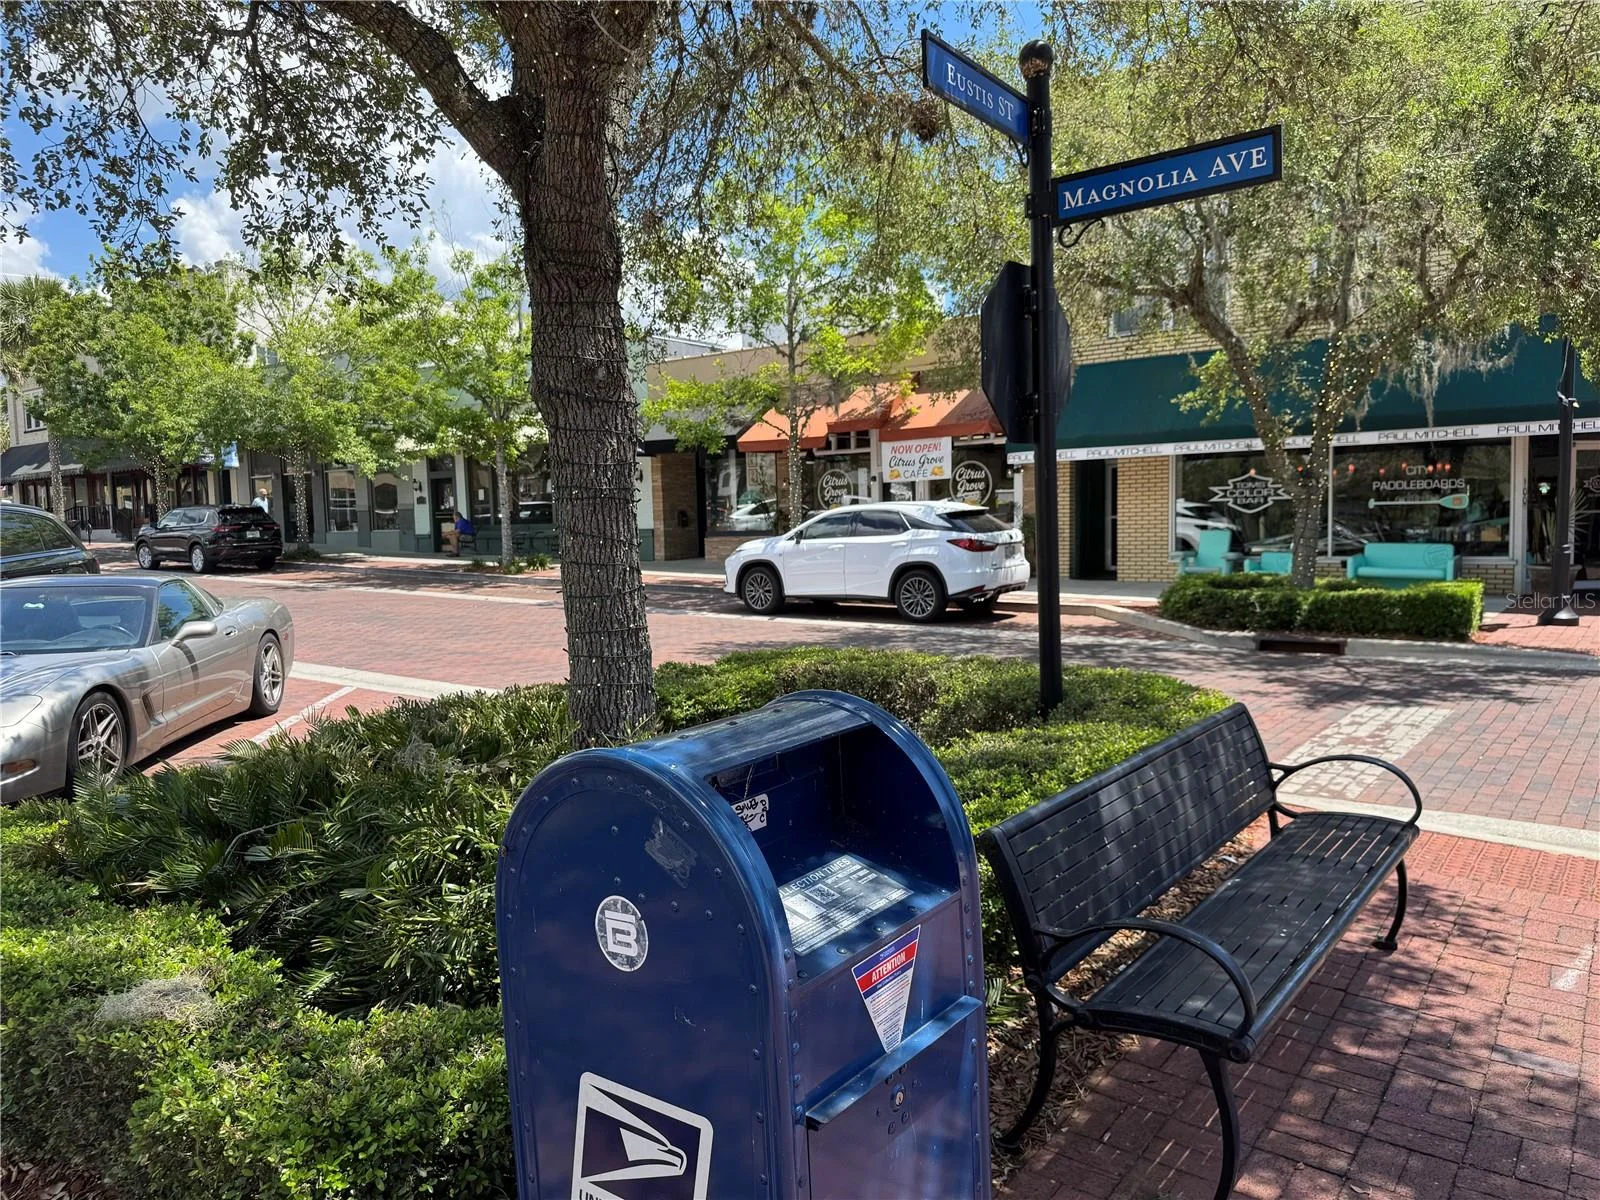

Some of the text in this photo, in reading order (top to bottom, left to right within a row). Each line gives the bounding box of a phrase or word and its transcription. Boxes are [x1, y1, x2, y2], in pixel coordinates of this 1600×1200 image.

[946, 62, 1015, 122] EUSTIS ST
[1063, 146, 1267, 211] MAGNOLIA AVE
[1378, 426, 1479, 442] PAUL MITCHELL
[1497, 424, 1536, 434] PAUL
[890, 442, 942, 455] NOW OPEN!
[1114, 446, 1162, 456] MITCHELL
[1174, 443, 1201, 451] PAUL
[889, 453, 945, 469] Citrus Grove
[1008, 453, 1032, 463] PAUL
[822, 475, 848, 488] Citrus
[903, 469, 928, 479] CAFE
[955, 466, 986, 482] Citrus
[824, 486, 848, 501] Grove
[956, 479, 986, 497] Grove
[1226, 488, 1275, 498] COLOR
[779, 871, 826, 896] LLECTION
[823, 858, 852, 874] TIMES
[871, 951, 906, 983] ATTENTION
